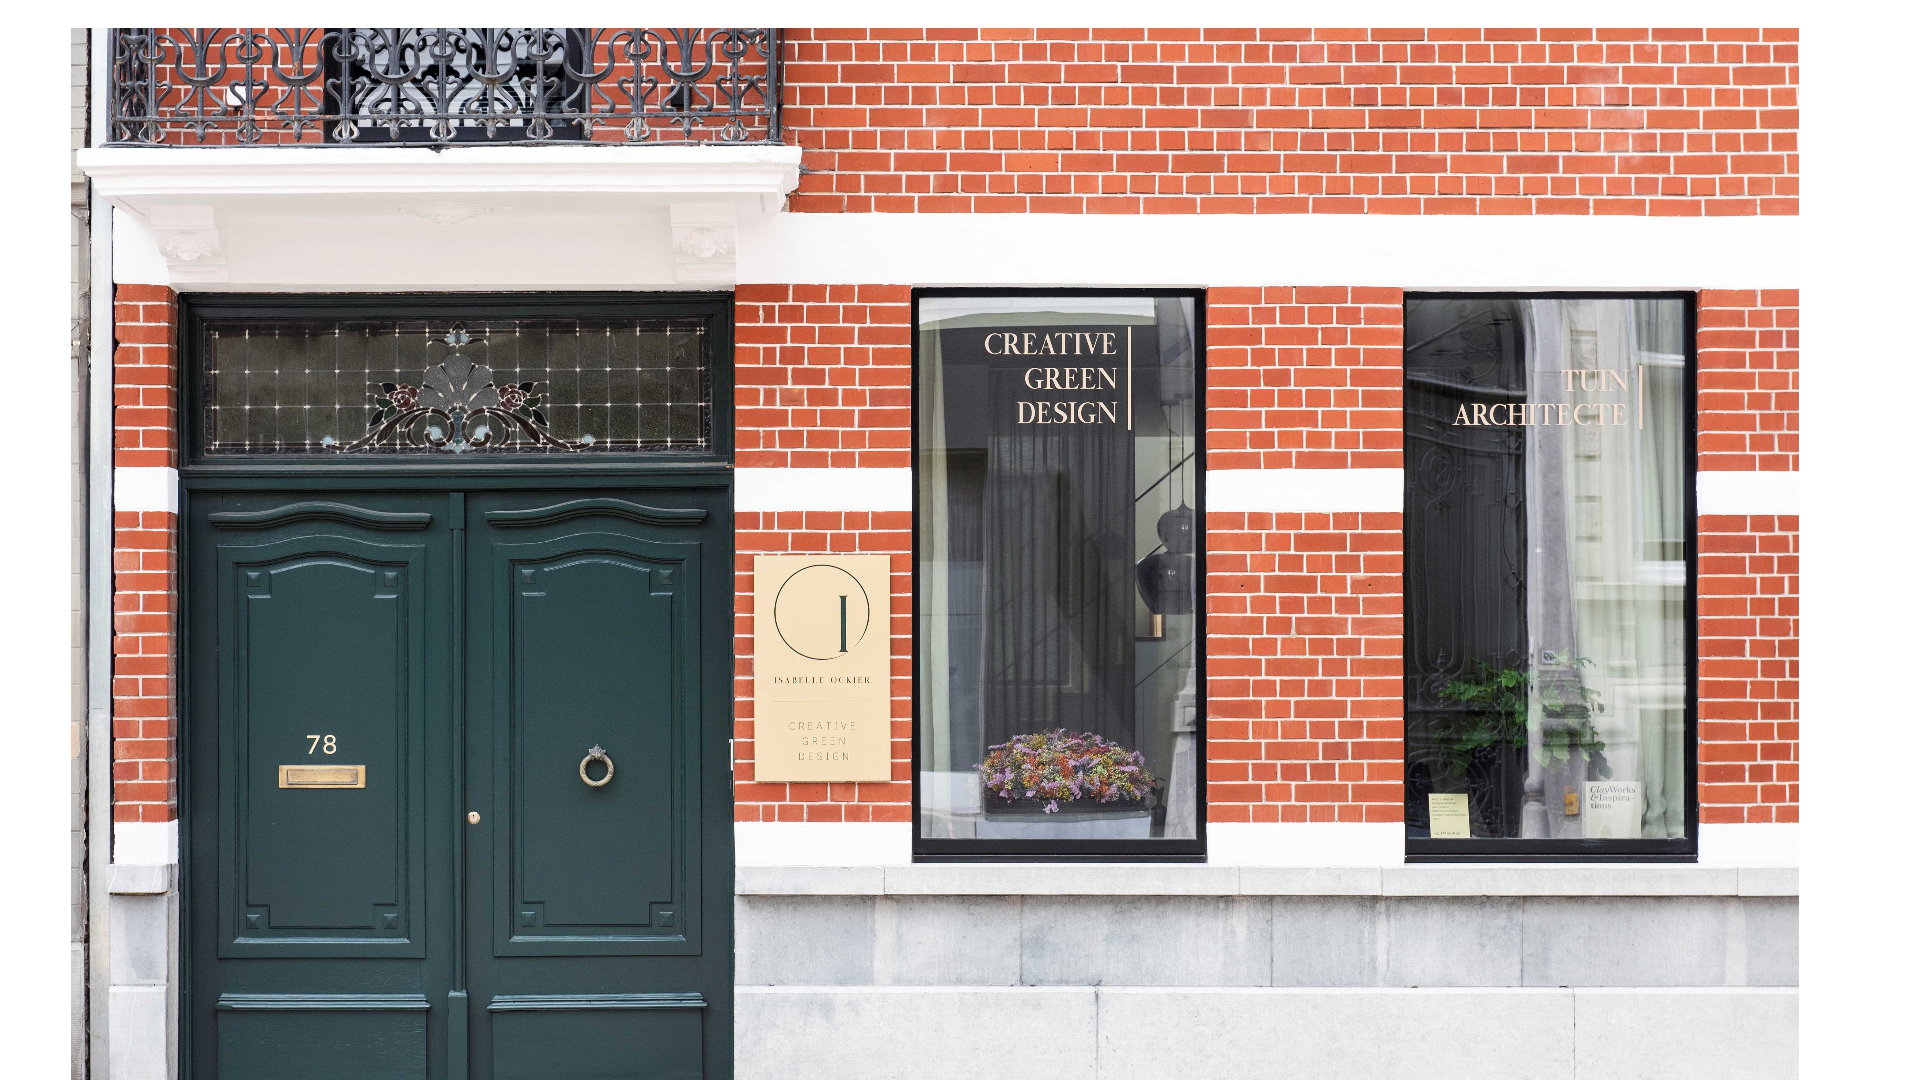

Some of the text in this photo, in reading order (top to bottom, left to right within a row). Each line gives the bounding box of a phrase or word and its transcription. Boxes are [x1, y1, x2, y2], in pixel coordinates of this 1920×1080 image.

[984, 332, 1117, 355] CREATIVE
[1024, 367, 1118, 390] GREEN
[1561, 369, 1630, 392] TUIN
[1016, 401, 1118, 424] DESIGN
[1451, 403, 1628, 426] ARCHITECTE
[774, 676, 871, 684] ISABELLE OCKIER
[788, 721, 856, 731] CREATIVE
[306, 734, 338, 755] 78
[802, 736, 846, 746] GREEN
[798, 752, 849, 761] DESIGN
[1590, 801, 1612, 809] tions
